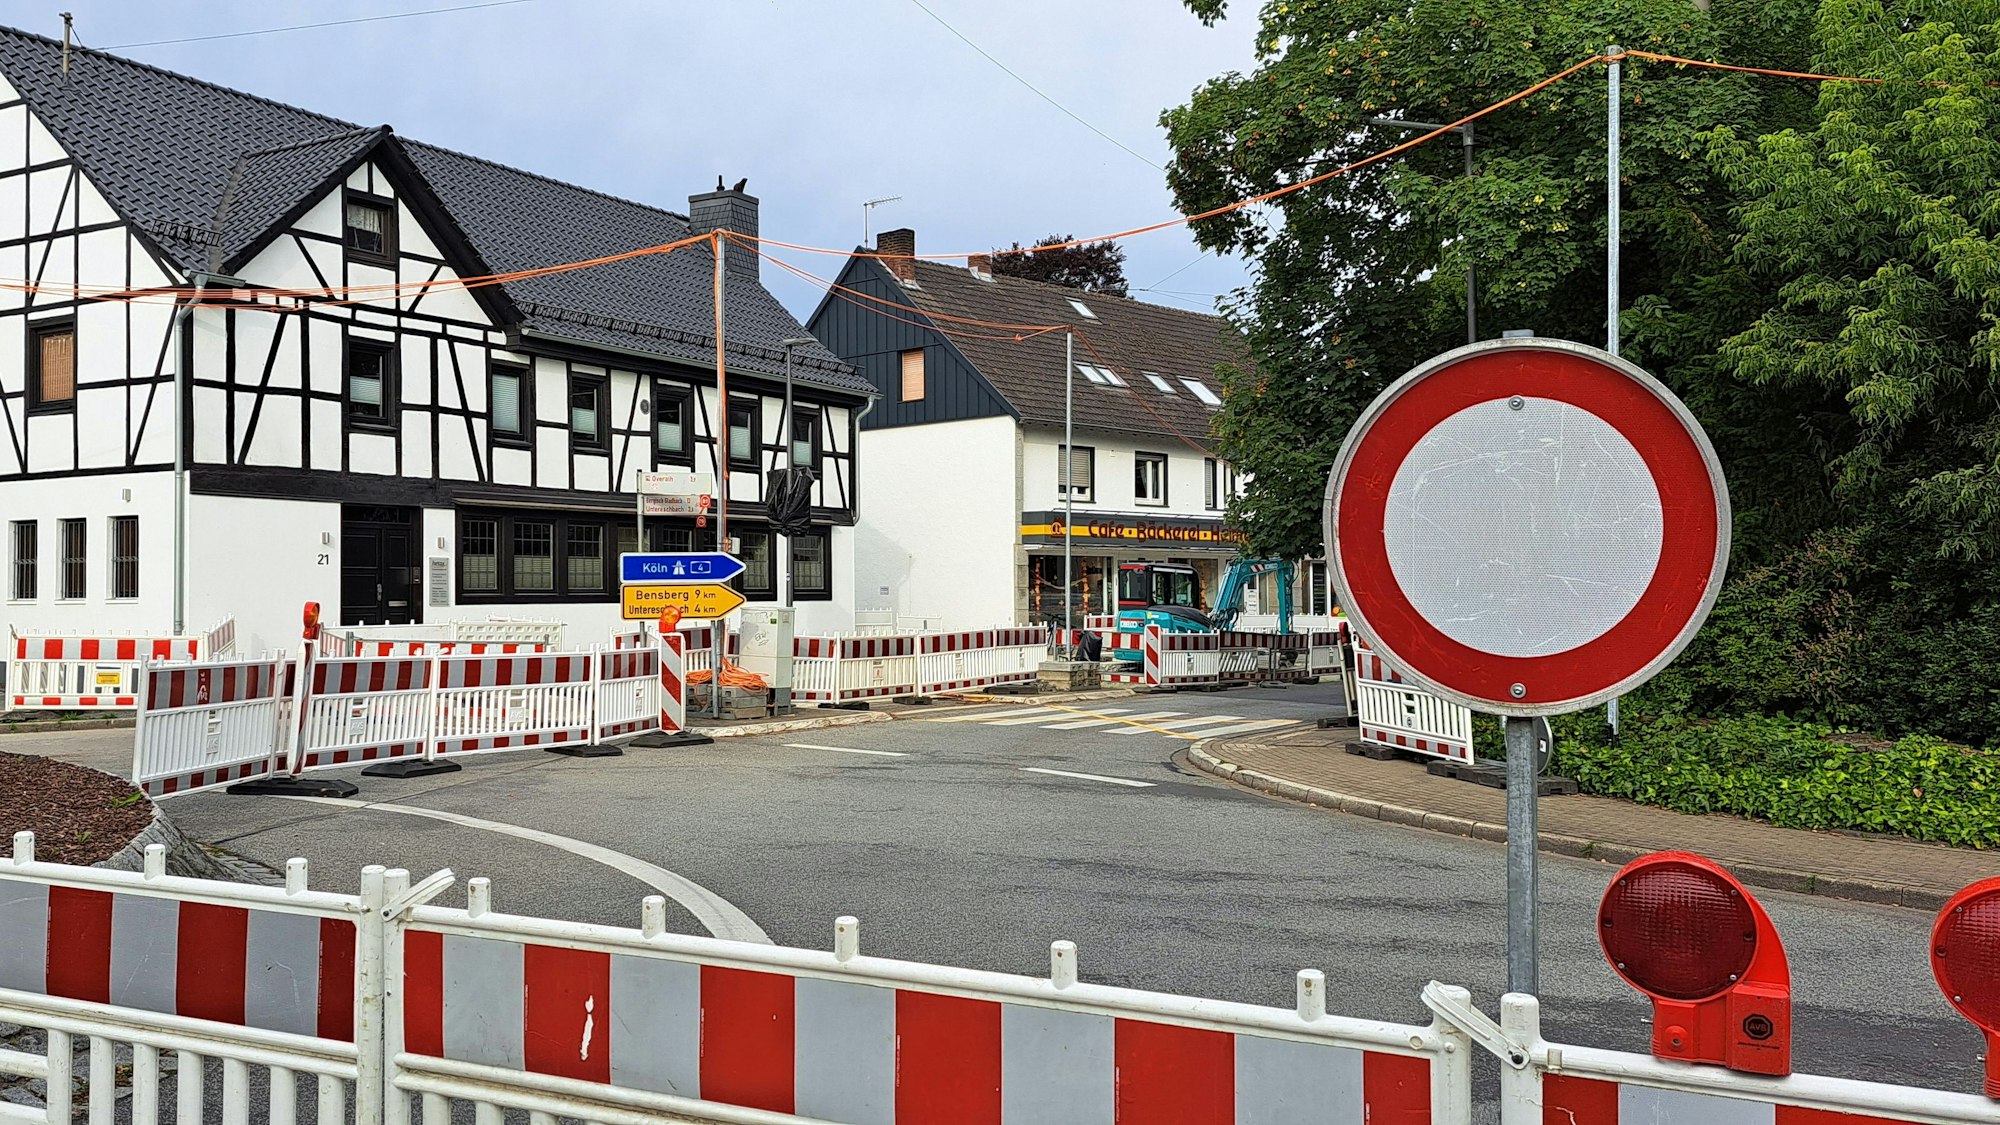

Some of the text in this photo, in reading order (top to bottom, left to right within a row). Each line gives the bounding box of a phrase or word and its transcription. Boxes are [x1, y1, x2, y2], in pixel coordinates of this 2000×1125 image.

[1088, 519, 1124, 538] Cafe
[1136, 520, 1200, 543] Bäckerei
[317, 554, 329, 565] 21
[642, 562, 704, 573] Köln 4
[636, 589, 717, 601] Bensberg 9 km
[694, 604, 701, 612] 4
[1749, 1022, 1767, 1031] AVS
